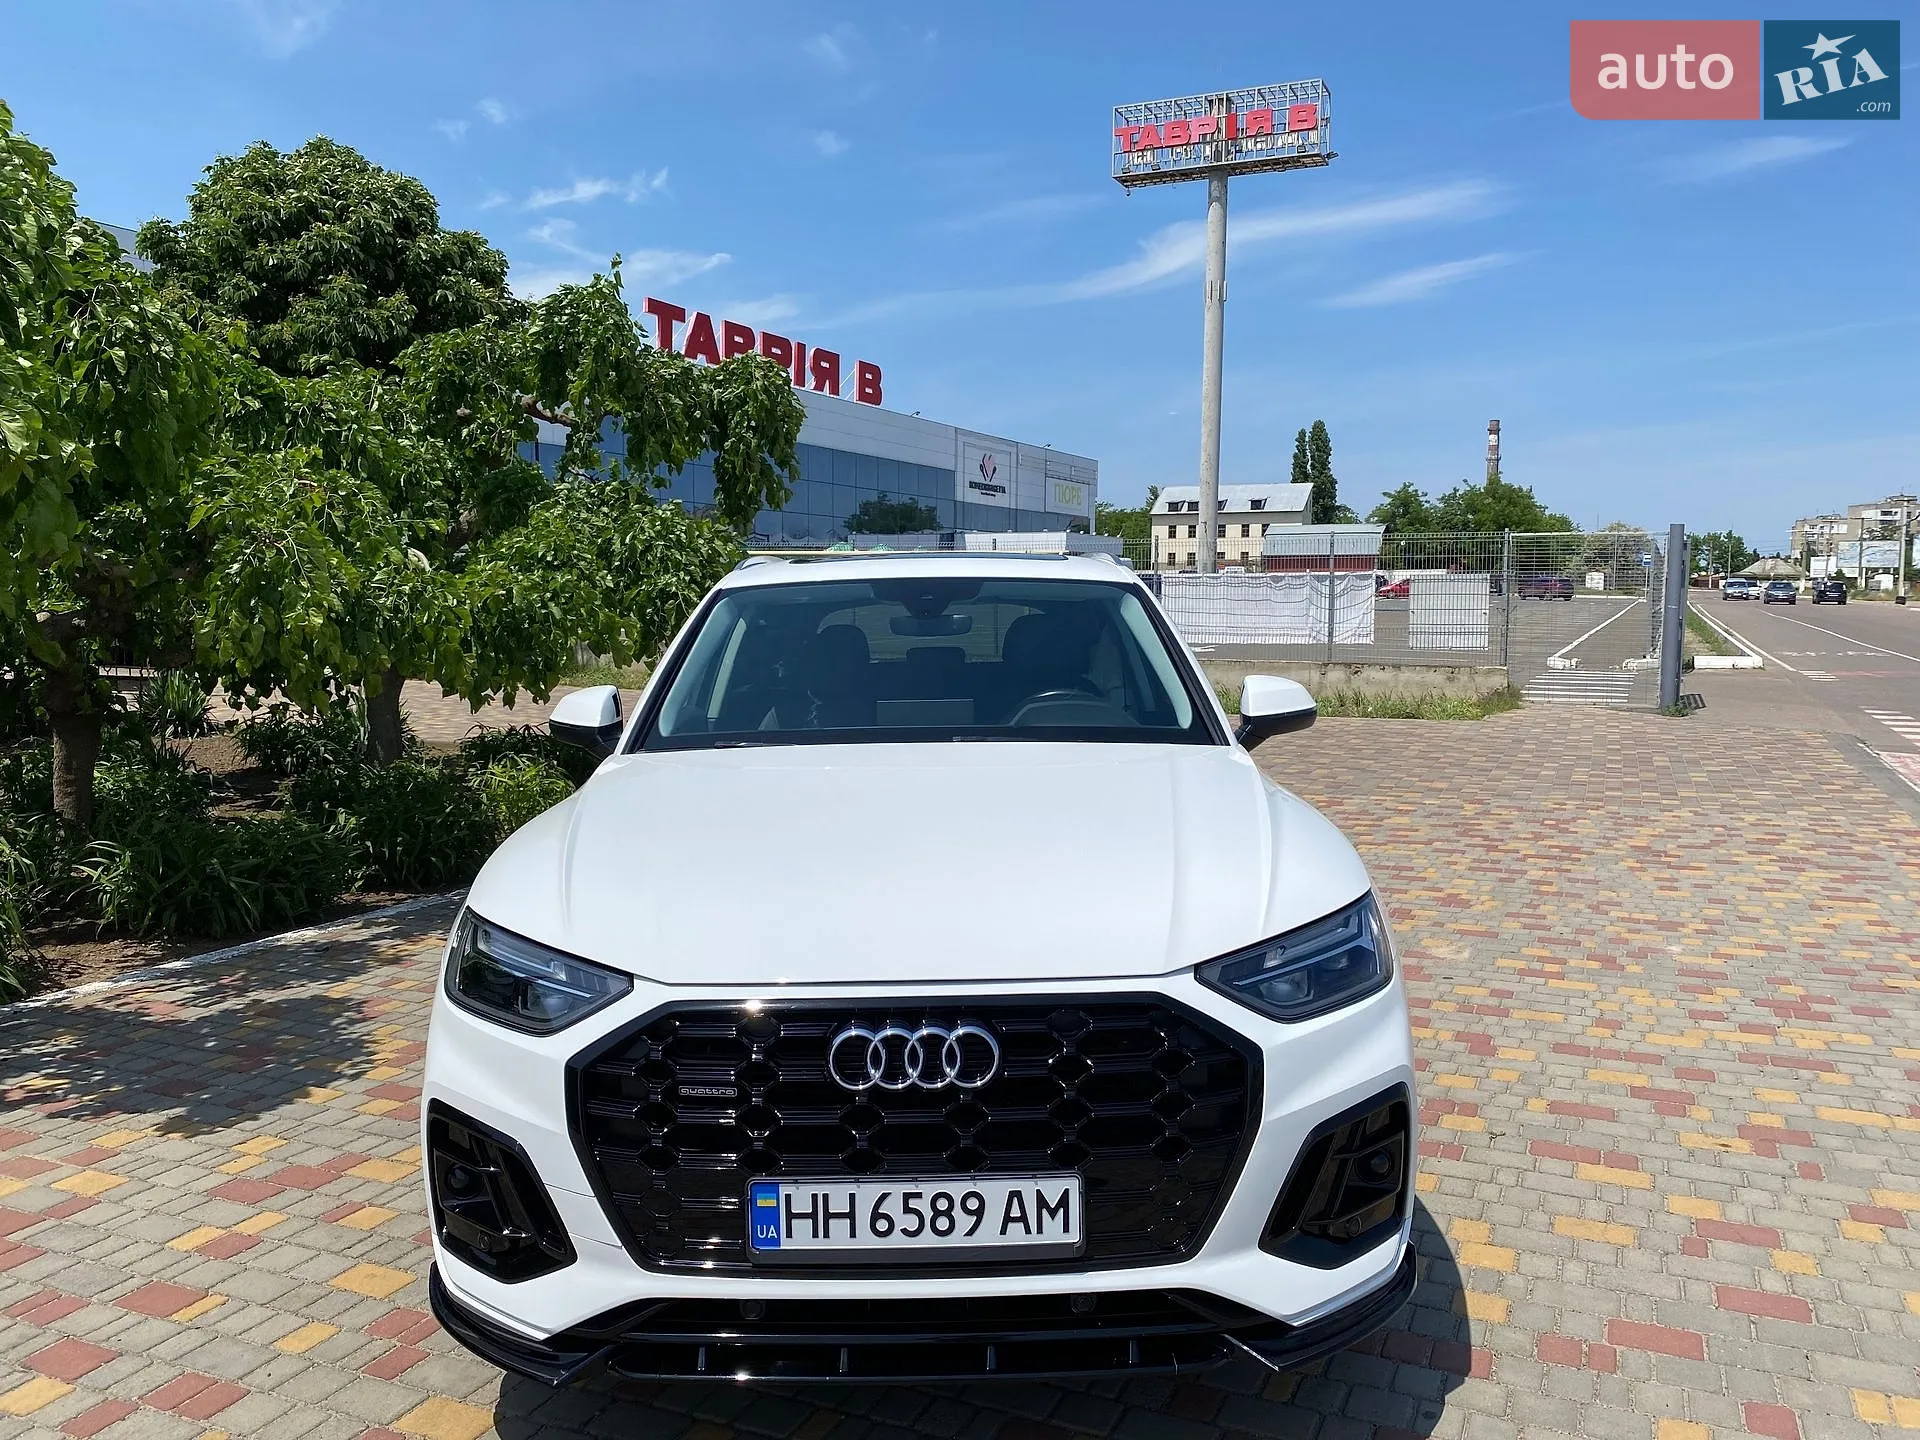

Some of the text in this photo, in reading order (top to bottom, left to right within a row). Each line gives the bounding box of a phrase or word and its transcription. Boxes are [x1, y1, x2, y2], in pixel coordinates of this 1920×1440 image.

[1114, 108, 1273, 152] ТАВРІЯ
[1288, 103, 1318, 132] В
[854, 360, 883, 406] В
[680, 1088, 735, 1096] quattro
[757, 1224, 778, 1239] UA
[869, 1190, 986, 1238] 6589
[999, 1187, 1070, 1236] AM
